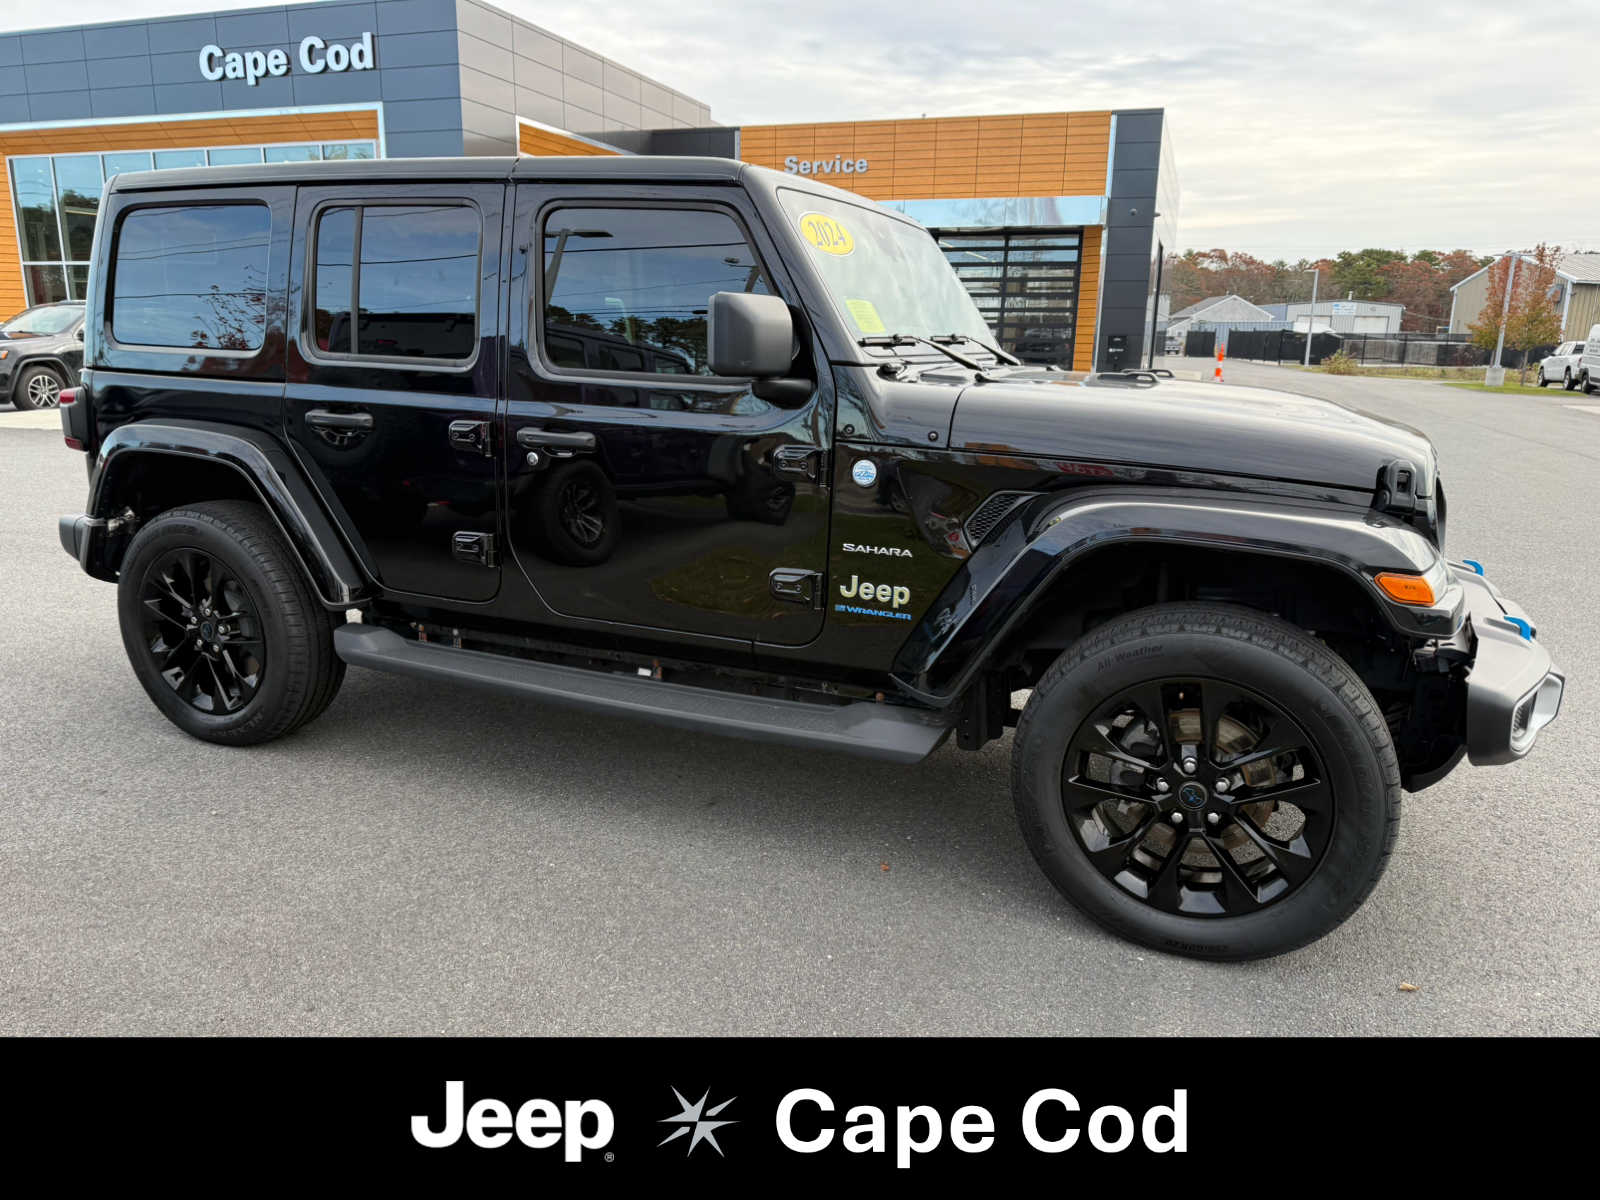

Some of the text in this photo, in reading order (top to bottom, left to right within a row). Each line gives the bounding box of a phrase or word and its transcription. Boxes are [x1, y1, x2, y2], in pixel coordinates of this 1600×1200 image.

[199, 31, 375, 86] Cape Cod
[784, 154, 869, 175] Service
[808, 220, 847, 247] 2024
[842, 543, 913, 558] SAHARA
[839, 574, 911, 609] Jeep
[846, 605, 913, 621] WRANGLER
